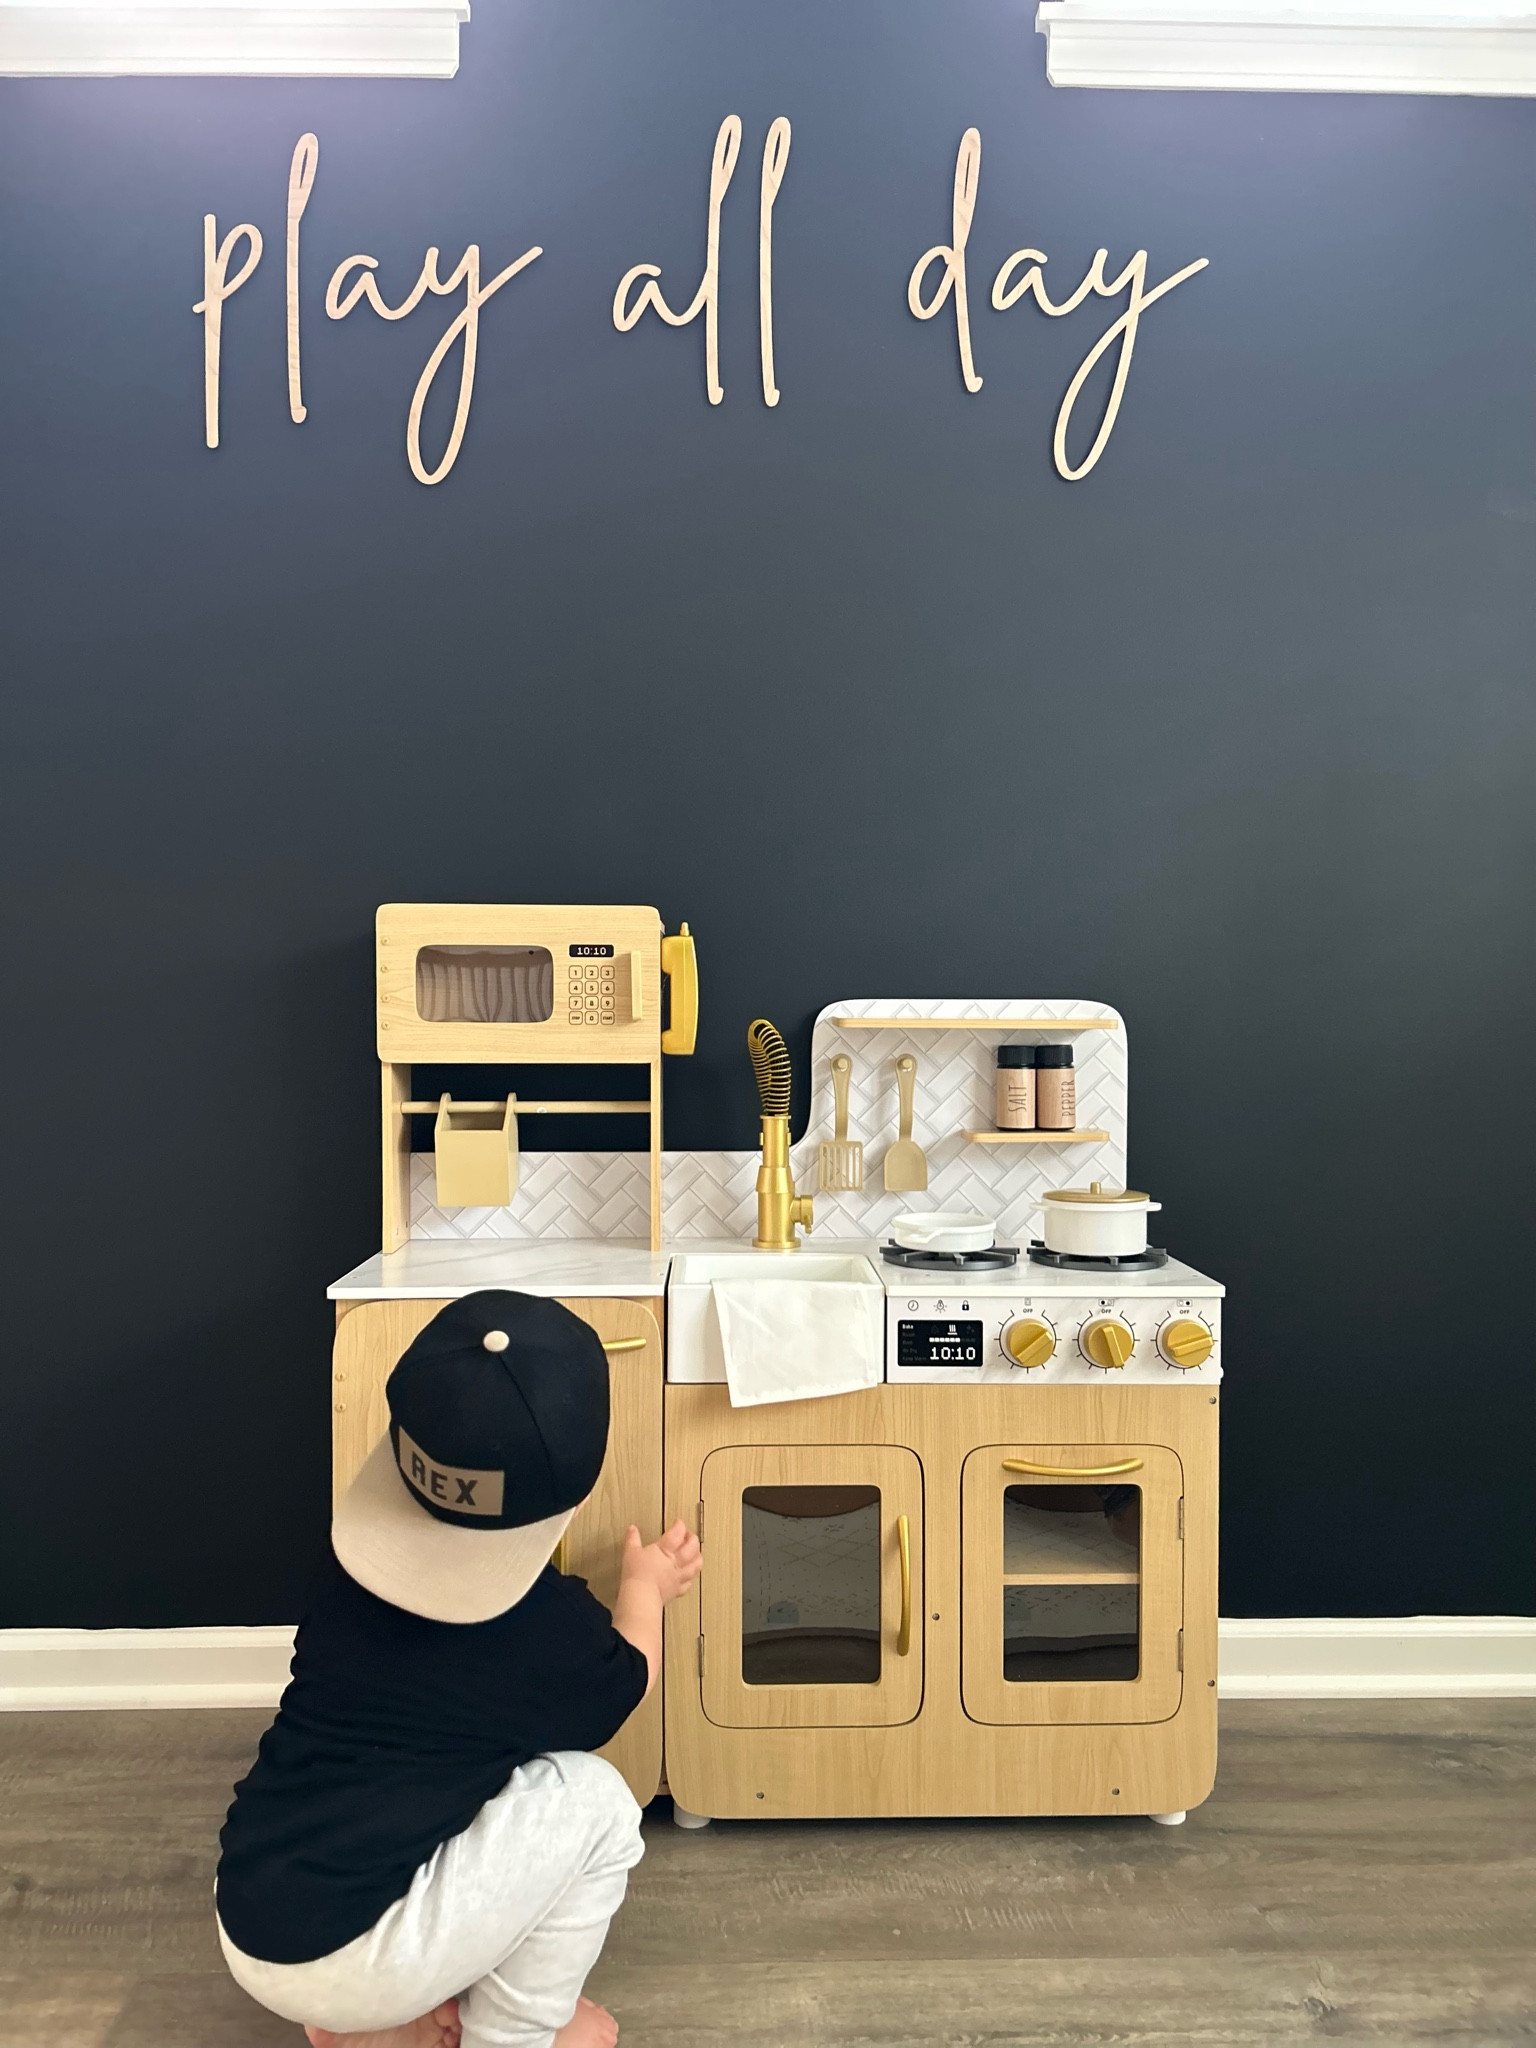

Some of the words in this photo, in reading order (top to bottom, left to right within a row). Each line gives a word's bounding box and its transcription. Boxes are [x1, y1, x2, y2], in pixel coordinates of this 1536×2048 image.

[193, 132, 543, 485] play
[612, 114, 792, 407] all
[907, 127, 1209, 482] day
[577, 946, 607, 955] 10:10
[1008, 1084, 1027, 1112] SALT
[1061, 1079, 1076, 1117] PEPPER
[929, 1346, 976, 1361] 10:10
[412, 1451, 478, 1506] REX
